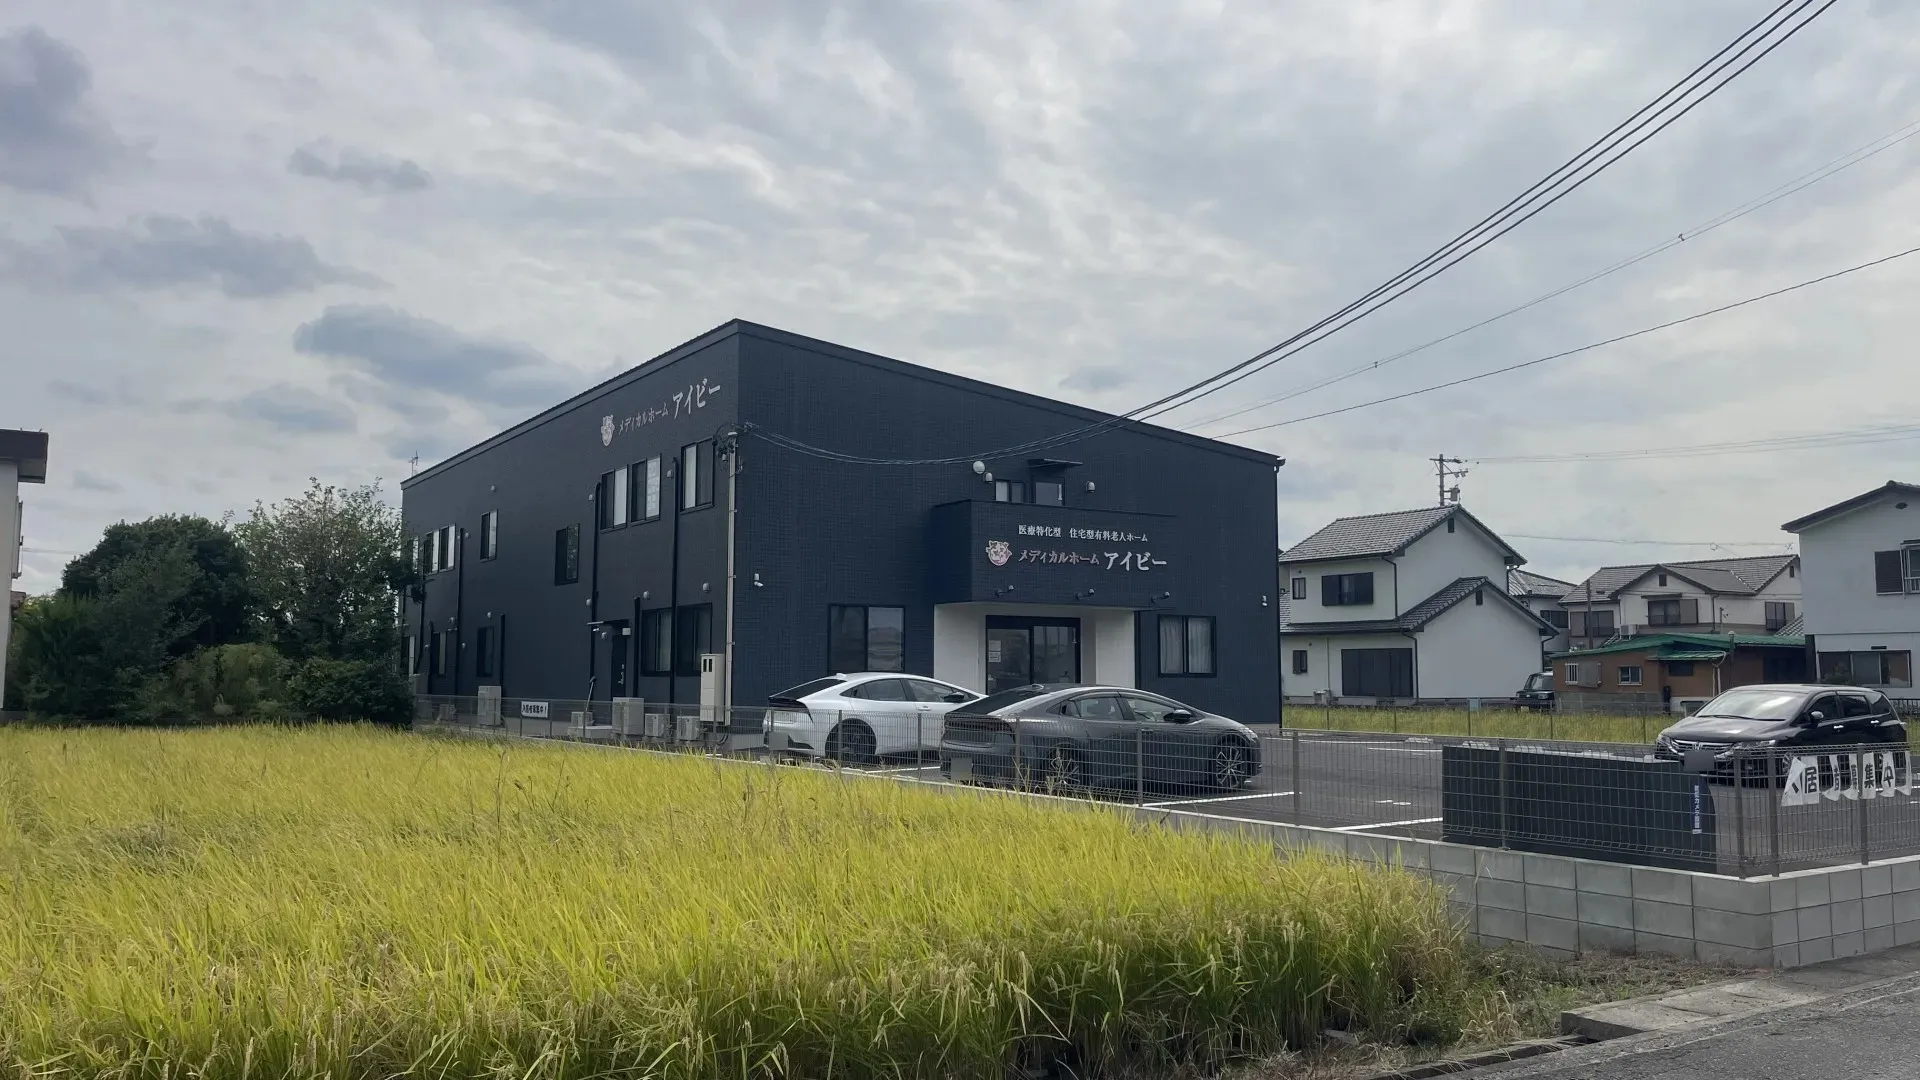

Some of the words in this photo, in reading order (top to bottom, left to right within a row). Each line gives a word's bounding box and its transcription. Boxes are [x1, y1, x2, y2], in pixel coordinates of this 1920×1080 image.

[619, 402, 669, 435] メディカルホーム
[673, 378, 721, 419] アイビー
[1018, 525, 1062, 538] 医療特化型
[1069, 528, 1148, 542] 住宅型有料老人ホーム
[1018, 550, 1100, 565] メディカルホーム
[1104, 551, 1167, 571] アイビー
